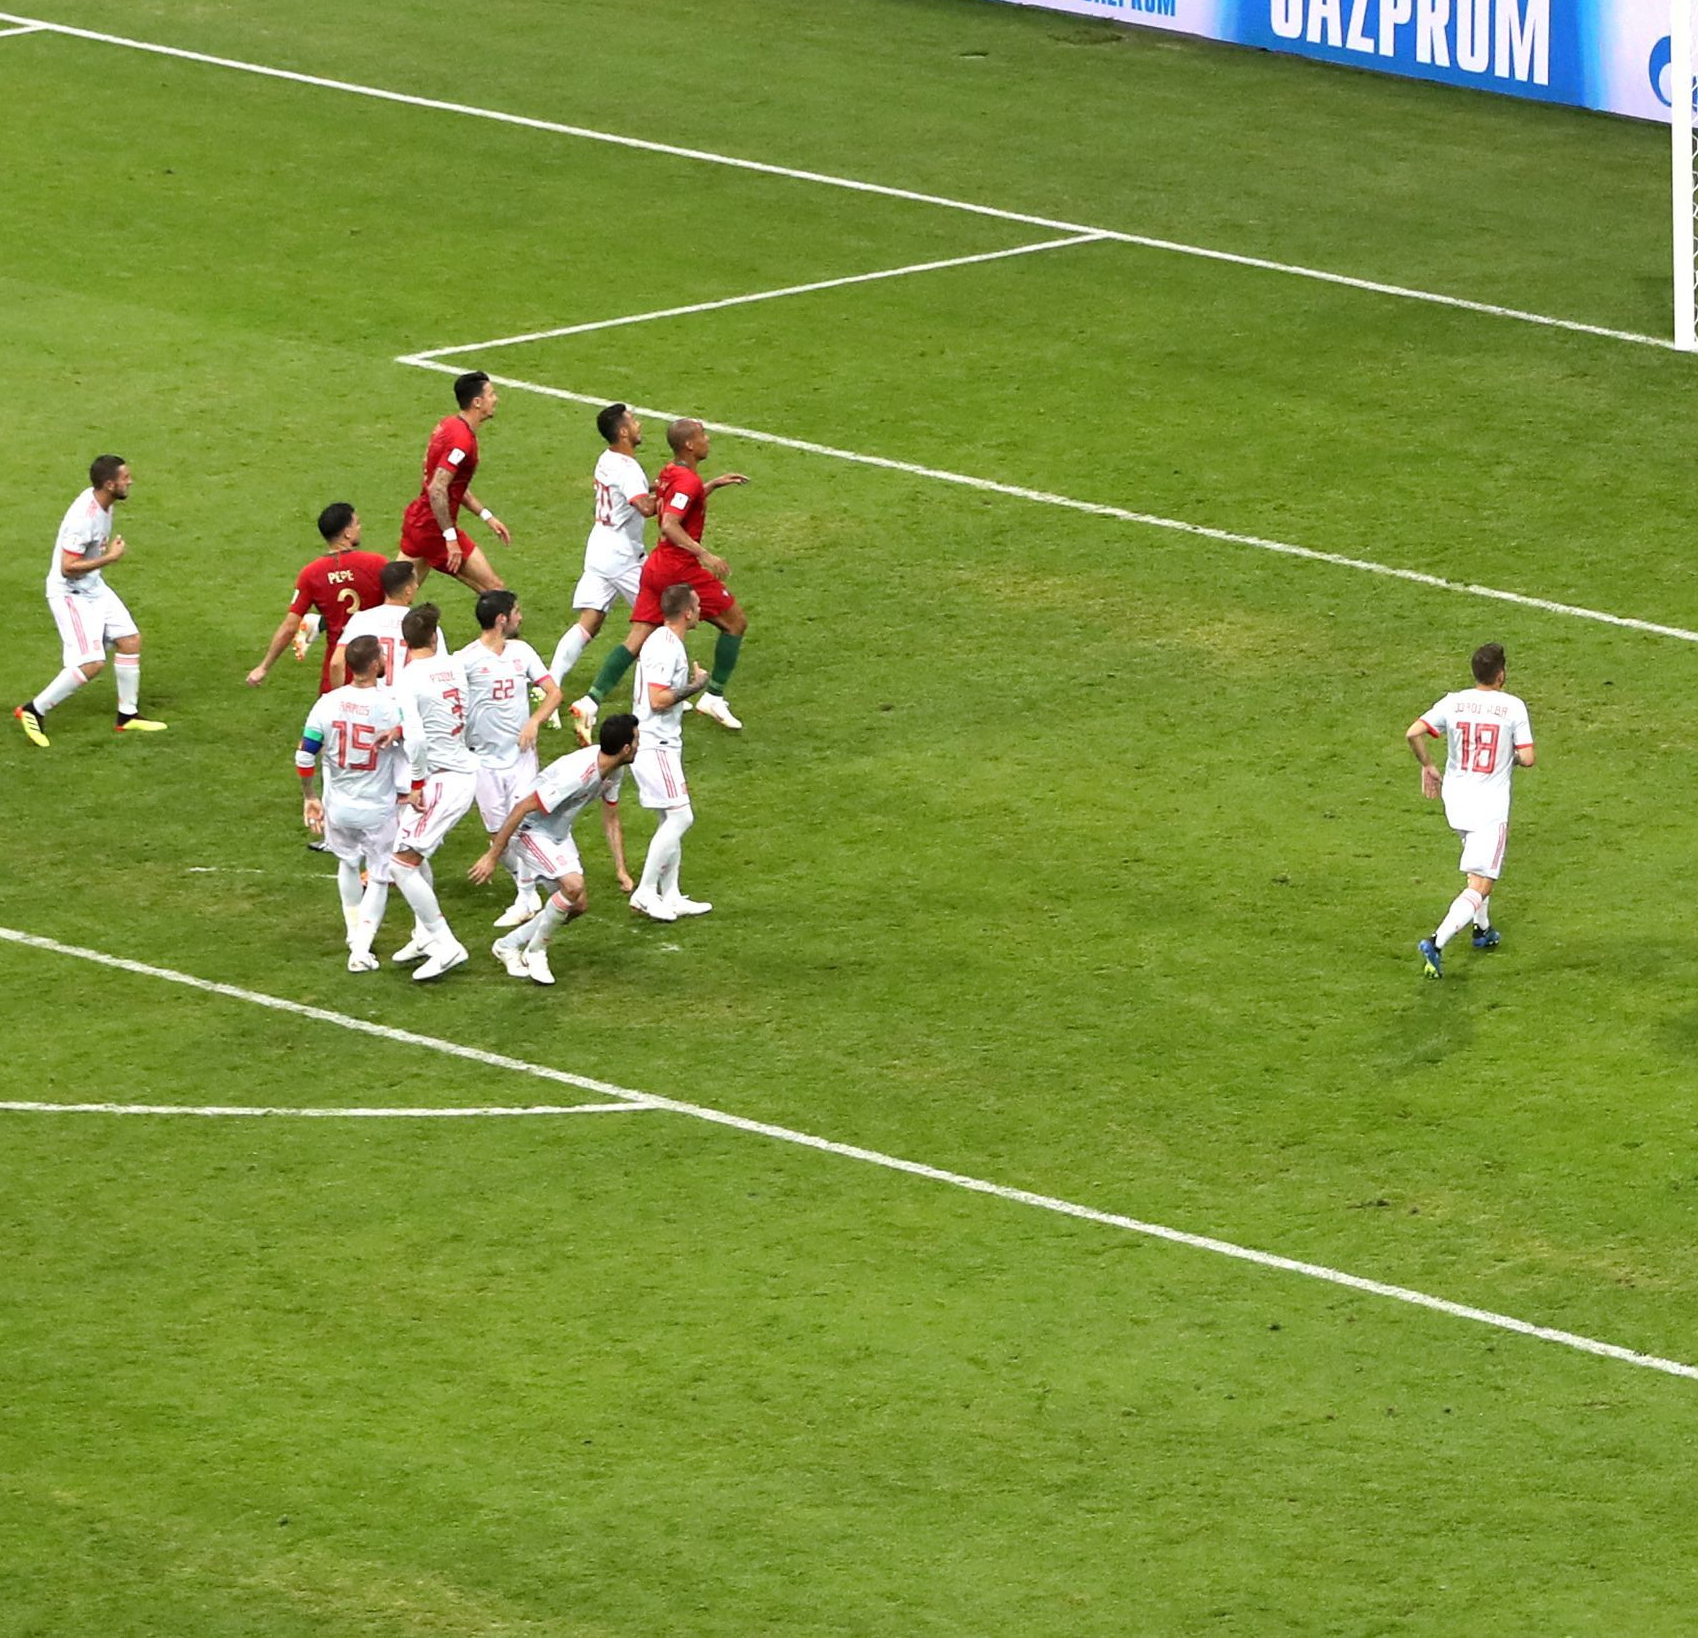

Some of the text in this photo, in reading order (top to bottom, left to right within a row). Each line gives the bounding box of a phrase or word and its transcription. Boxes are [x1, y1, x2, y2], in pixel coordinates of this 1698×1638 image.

[327, 570, 354, 584] PEPE
[492, 679, 515, 700] 22
[332, 720, 377, 771] 15
[1456, 721, 1500, 774] 18
